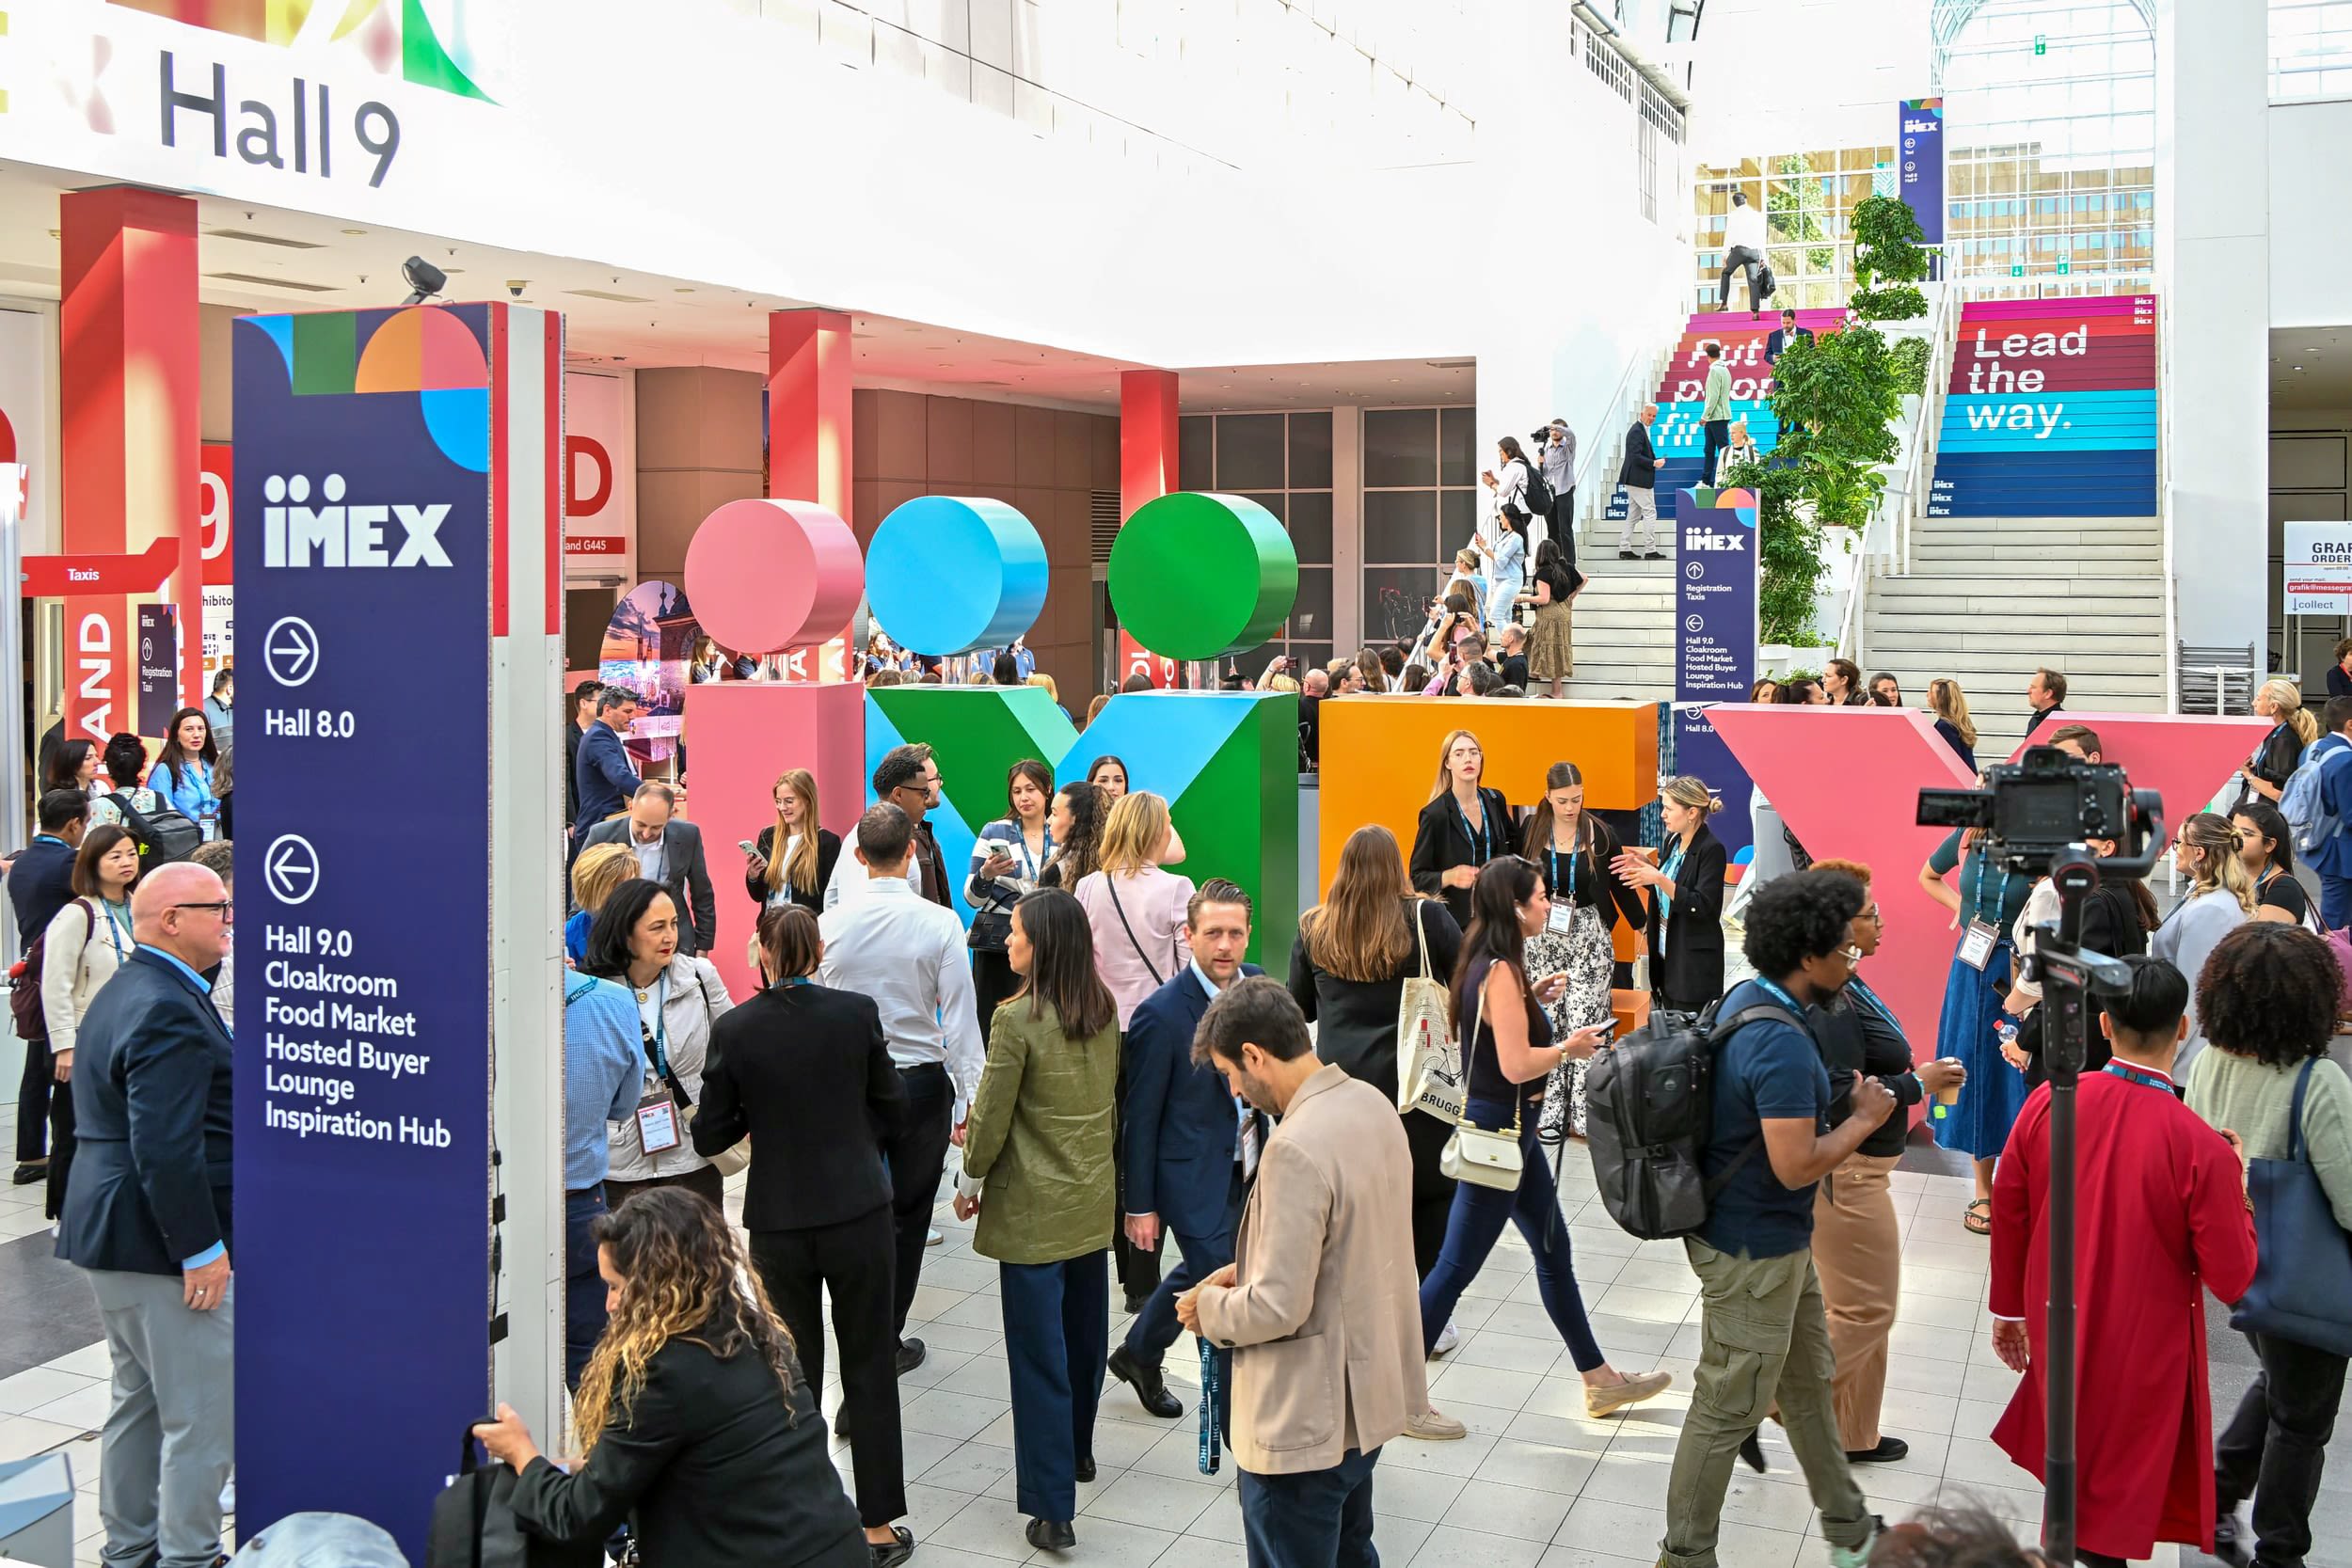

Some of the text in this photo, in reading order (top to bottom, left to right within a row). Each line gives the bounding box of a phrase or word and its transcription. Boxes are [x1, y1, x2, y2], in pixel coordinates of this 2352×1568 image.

[160, 50, 330, 178] Hall
[355, 101, 401, 188] 9
[1975, 325, 2087, 358] Lead
[1967, 361, 2044, 394] the
[1966, 403, 2072, 439] way.
[583, 540, 606, 551] G445
[68, 568, 99, 581] Taxis
[1686, 584, 1732, 593] Registration
[202, 595, 233, 606] hibito
[2299, 600, 2333, 609] collect
[142, 666, 173, 679] Registration
[1686, 673, 1714, 681] Lounge
[1715, 664, 1737, 673] Buyer
[1686, 681, 1725, 689] Inspiration
[265, 708, 355, 738] Hall 8.0
[265, 925, 353, 957] Hall 9.0
[265, 960, 397, 998] Cloakroom
[266, 996, 416, 1037] Food Market
[266, 1032, 430, 1079] Hosted Buyer
[266, 1064, 355, 1105] Lounge
[1421, 1092, 1460, 1116] BRUGG
[266, 1101, 451, 1148] Inspiration Hub
